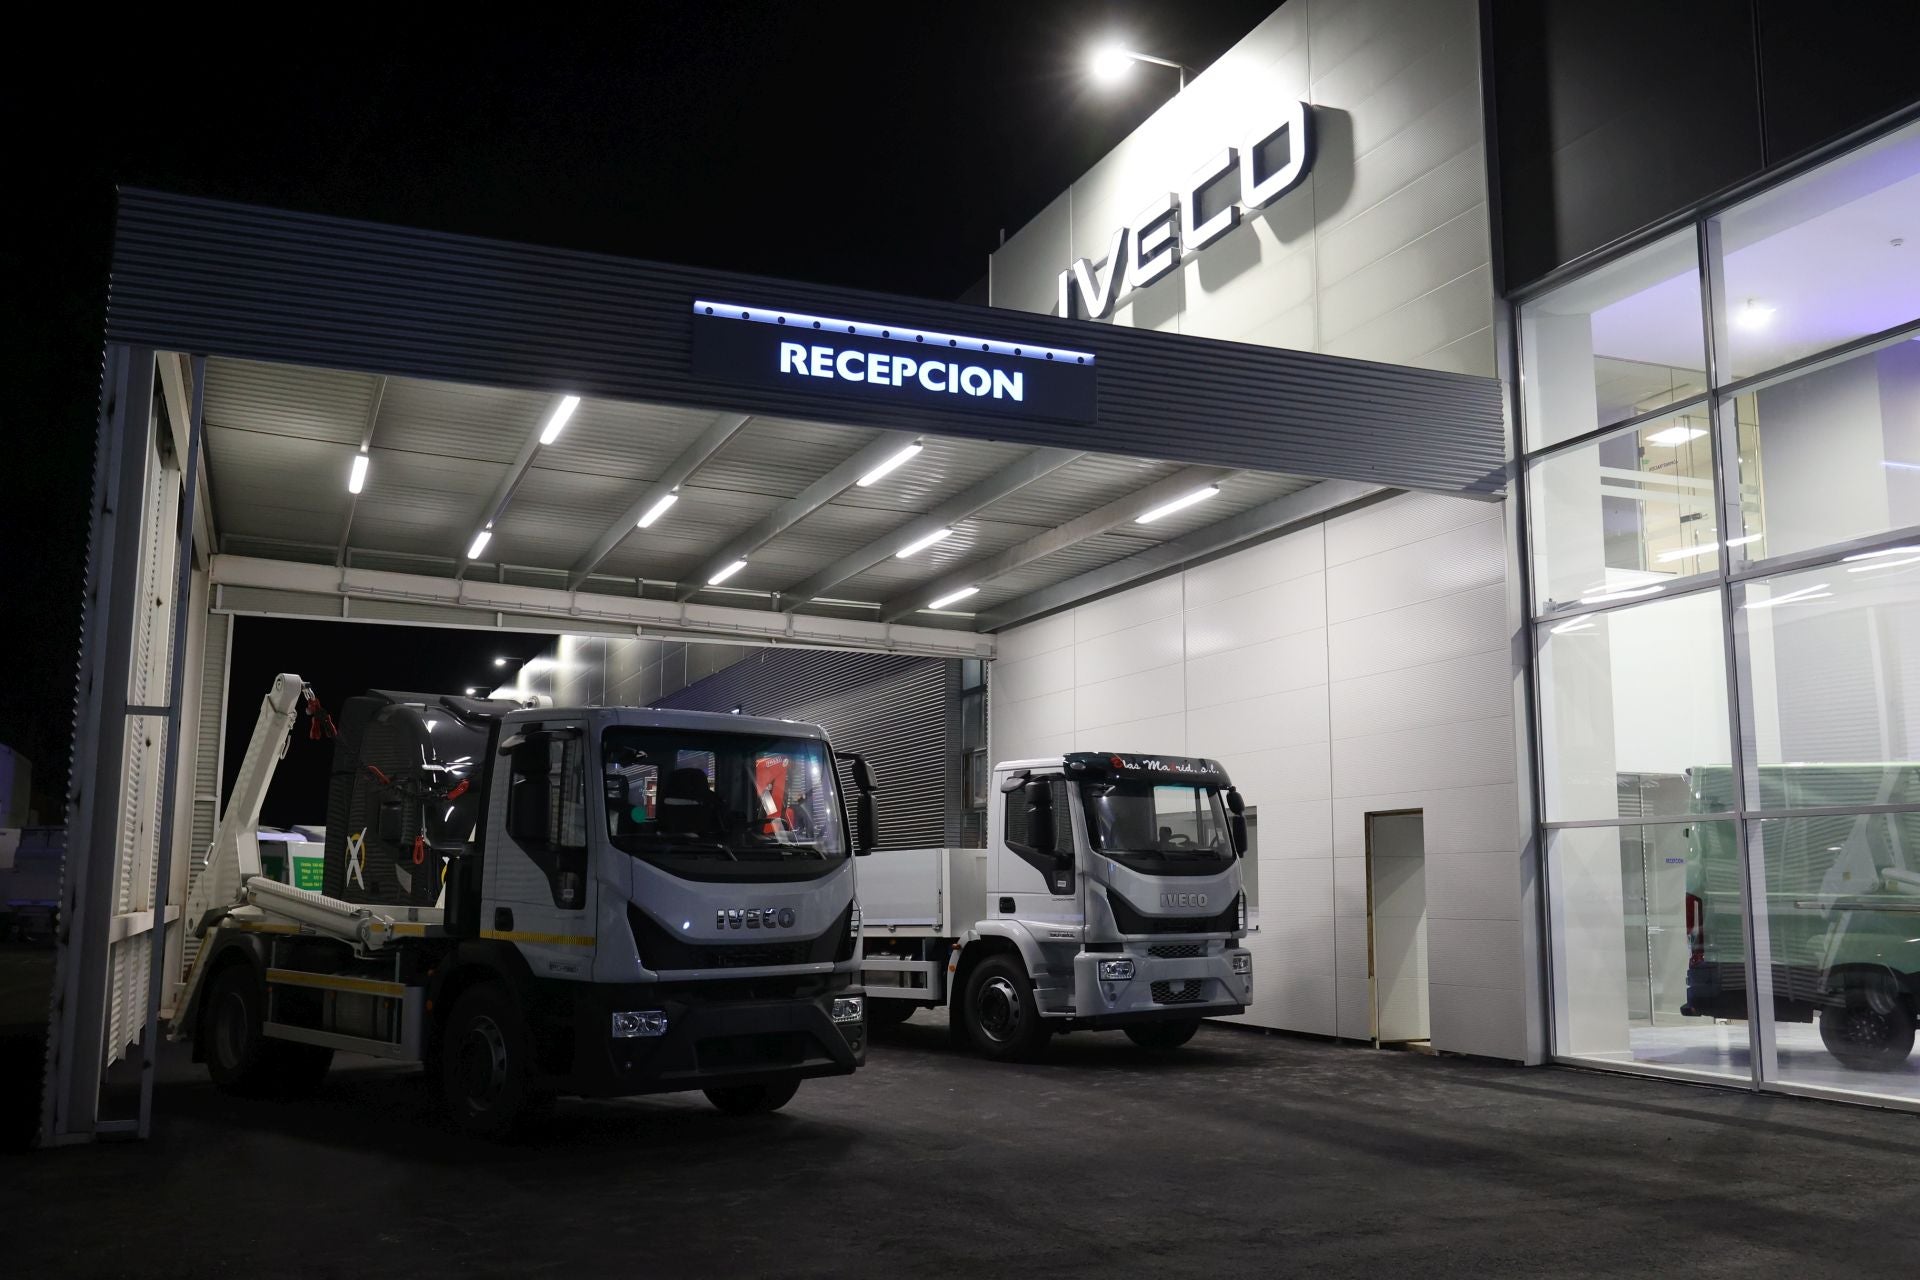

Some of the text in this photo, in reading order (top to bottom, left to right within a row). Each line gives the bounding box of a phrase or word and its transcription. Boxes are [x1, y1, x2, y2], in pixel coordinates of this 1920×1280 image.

[1058, 100, 1311, 318] IVECO
[780, 341, 1024, 402] RECEPCION
[716, 908, 797, 930] IVECO
[1160, 892, 1208, 908] IVECO
